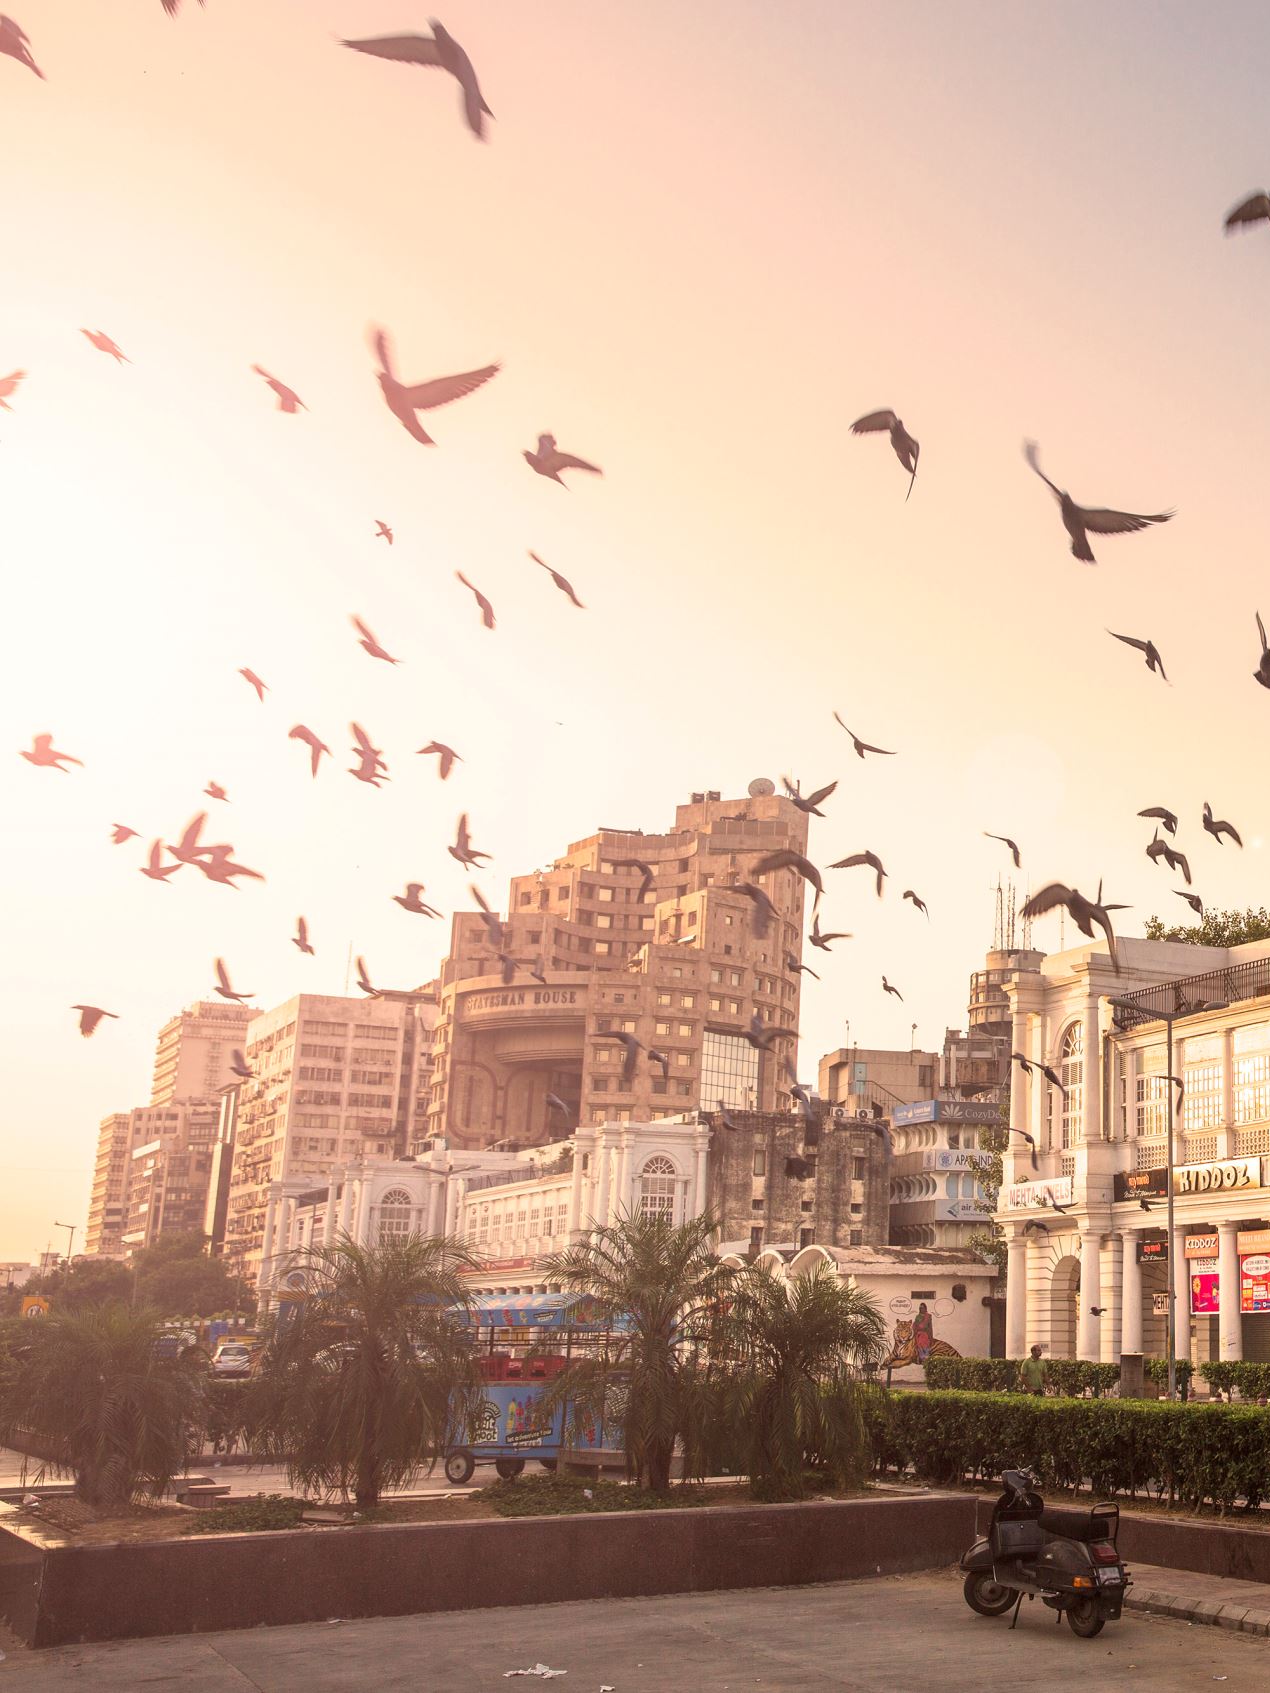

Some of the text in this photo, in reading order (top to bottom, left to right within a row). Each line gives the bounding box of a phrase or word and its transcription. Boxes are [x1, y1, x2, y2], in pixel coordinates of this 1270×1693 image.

[467, 991, 576, 1011] STATESMAN HOUSE
[1179, 1163, 1250, 1192] KIDDOZ
[1009, 1188, 1035, 1206] MEHTA
[1186, 1237, 1217, 1250] KIDDOZ
